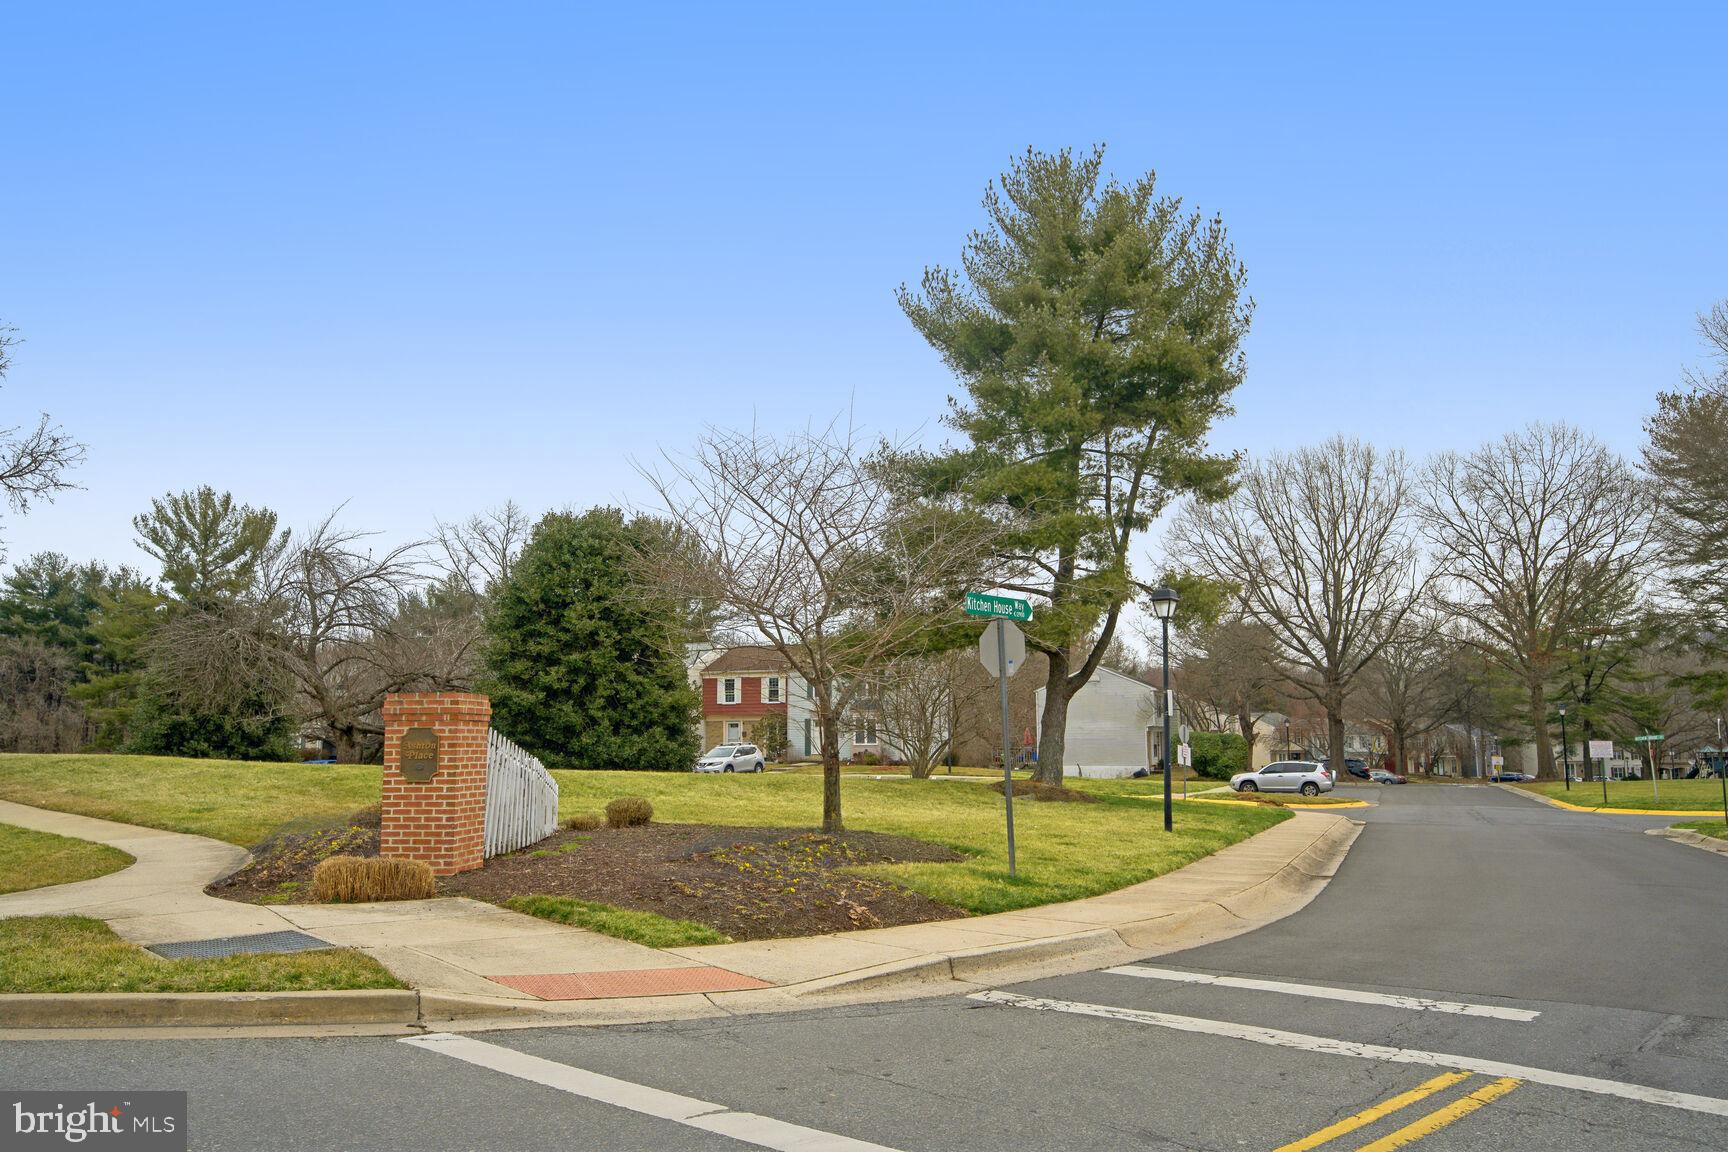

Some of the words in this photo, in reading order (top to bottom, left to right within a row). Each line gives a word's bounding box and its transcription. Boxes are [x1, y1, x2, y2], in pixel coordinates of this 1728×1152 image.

[967, 597, 992, 612] Kitchen
[994, 601, 1012, 614] House
[1014, 600, 1024, 612] Way
